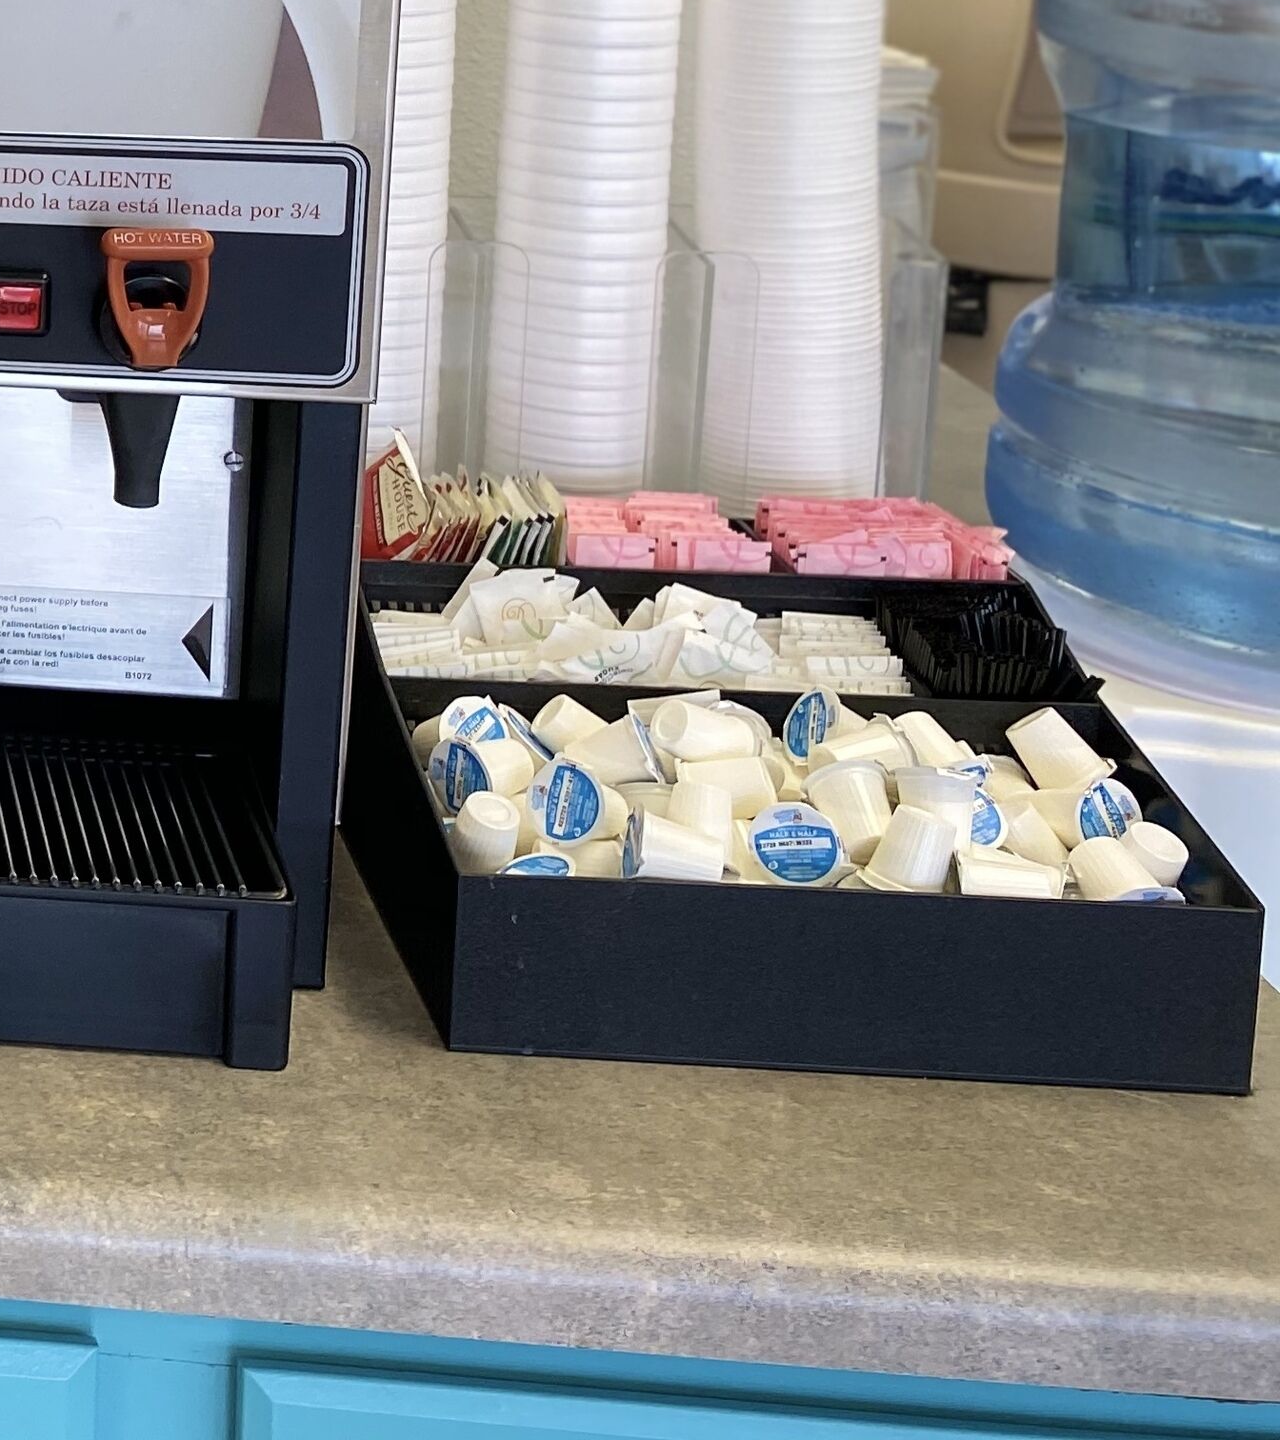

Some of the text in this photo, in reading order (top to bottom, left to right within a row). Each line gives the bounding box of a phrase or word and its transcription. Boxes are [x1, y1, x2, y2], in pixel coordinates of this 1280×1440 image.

[51, 168, 172, 190] CALIENTE
[42, 193, 60, 210] la
[68, 197, 110, 212] taza
[117, 198, 158, 214] está
[167, 198, 242, 217] llenada
[250, 204, 284, 221] por
[290, 202, 321, 220] 3/4
[113, 231, 203, 245] HOT WATER
[391, 477, 406, 534] HOUSE
[19, 596, 47, 604] power
[49, 597, 78, 607] supply
[81, 598, 108, 607] before
[109, 627, 134, 635] avant
[136, 628, 147, 636] de
[7, 648, 42, 656] cambiar
[44, 649, 58, 657] los
[60, 650, 94, 659] fusibles
[96, 653, 146, 663] desacoplar
[31, 658, 40, 666] la
[125, 672, 153, 680] B1072
[797, 829, 818, 838] HALF
